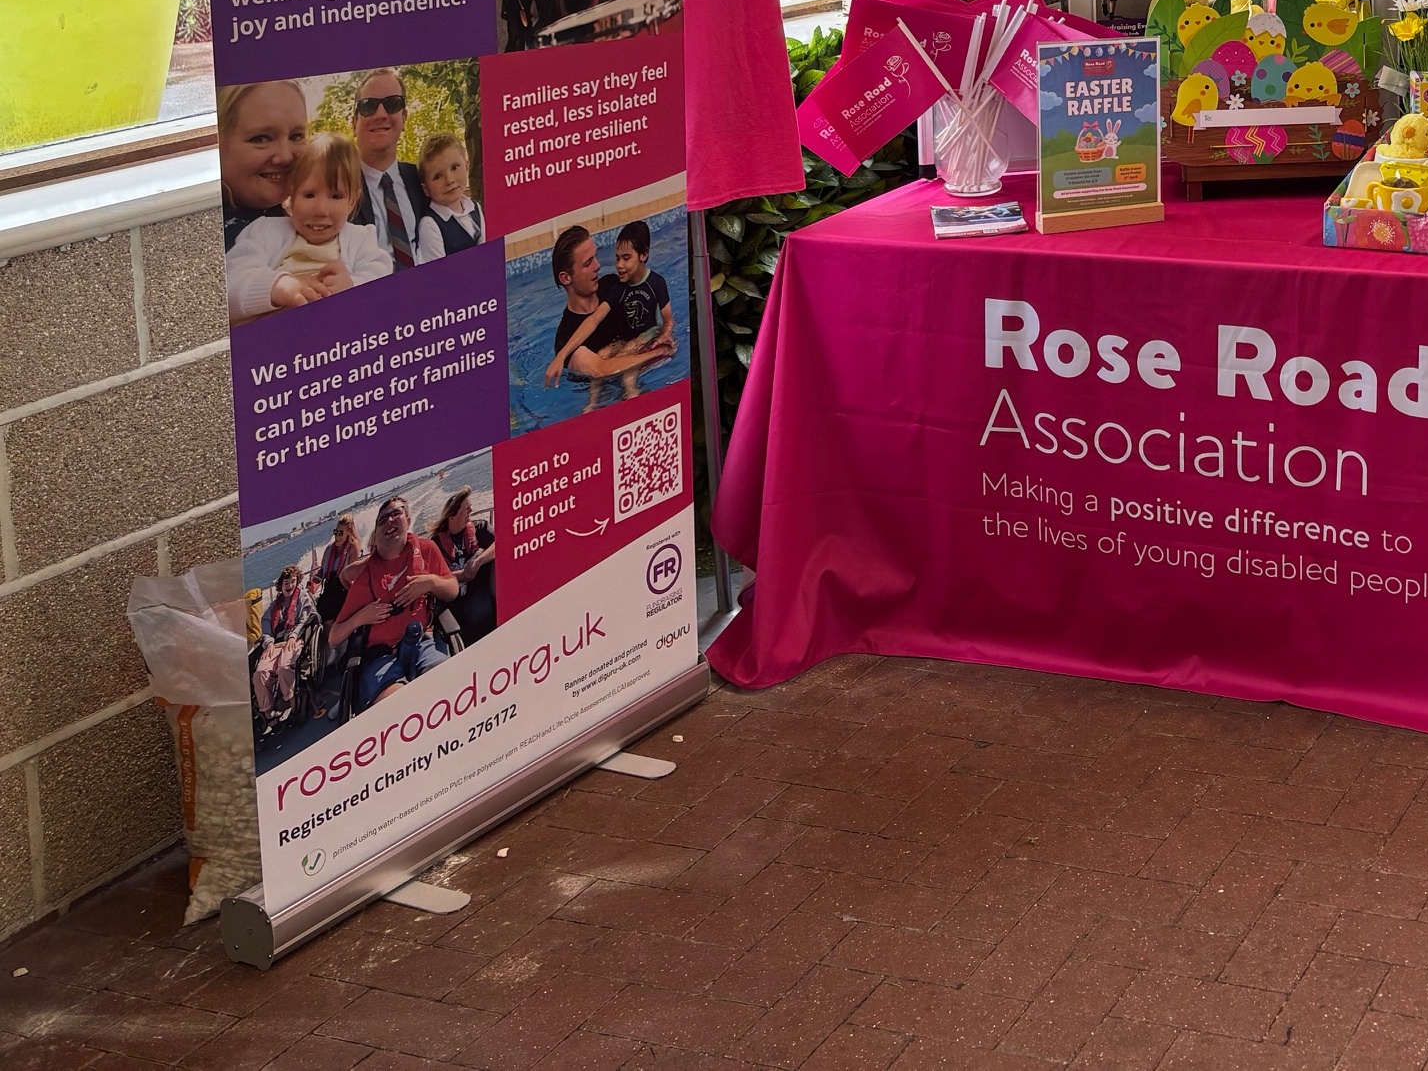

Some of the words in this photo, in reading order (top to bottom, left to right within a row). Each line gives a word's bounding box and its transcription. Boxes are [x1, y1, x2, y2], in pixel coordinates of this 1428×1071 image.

[230, 16, 268, 43] joy
[274, 6, 314, 31] and
[1020, 48, 1038, 68] Ros
[503, 84, 569, 112] Families
[572, 79, 600, 98] say
[603, 71, 638, 90] they
[641, 61, 667, 82] feel
[841, 100, 865, 120] Rose
[863, 76, 893, 102] Road
[1065, 78, 1133, 98] EASTER
[1067, 96, 1132, 117] RAFFLE
[504, 109, 559, 137] rested,
[563, 105, 593, 123] less
[597, 87, 657, 116] isolated
[849, 93, 893, 129] Association
[504, 138, 534, 162] and
[539, 132, 581, 154] more
[585, 115, 648, 143] resilient
[504, 163, 541, 187] with
[545, 158, 573, 176] our
[576, 141, 641, 169] support.
[250, 362, 287, 386] We
[292, 331, 389, 374] fundraise
[394, 324, 415, 341] to
[420, 298, 497, 333] enhance
[984, 297, 1181, 389] Rose
[253, 389, 293, 414] our
[299, 374, 343, 400] care
[348, 354, 384, 383] and
[390, 337, 455, 369] ensure
[459, 327, 486, 346] we
[255, 418, 294, 442] can
[301, 407, 326, 428] be
[330, 387, 384, 417] there
[389, 374, 418, 396] for
[422, 349, 495, 385] families
[255, 447, 289, 471] for
[295, 433, 330, 457] the
[335, 415, 378, 443] long
[381, 399, 434, 425] term.
[979, 388, 1368, 496] Association
[511, 460, 548, 487] Scan
[552, 452, 570, 468] to
[512, 476, 568, 510] donate
[572, 457, 601, 484] and
[512, 505, 544, 535] find
[548, 495, 576, 518] out
[982, 472, 1073, 516] Making
[1085, 494, 1098, 512] a
[1110, 497, 1213, 529] positive
[1224, 507, 1370, 548] difference
[1381, 530, 1412, 554] to
[514, 529, 556, 559] more
[982, 513, 1029, 538] the
[1038, 518, 1088, 550] lives
[1097, 531, 1127, 555] of
[1133, 541, 1215, 578] young
[1226, 549, 1337, 585] disabled
[653, 557, 676, 584] FR
[646, 594, 683, 618] REGULATOR
[277, 611, 607, 811] roseroad.org.uk
[278, 783, 370, 847] Registered
[374, 752, 433, 793] Charity
[437, 739, 464, 759] No.
[468, 703, 517, 743] 276172
